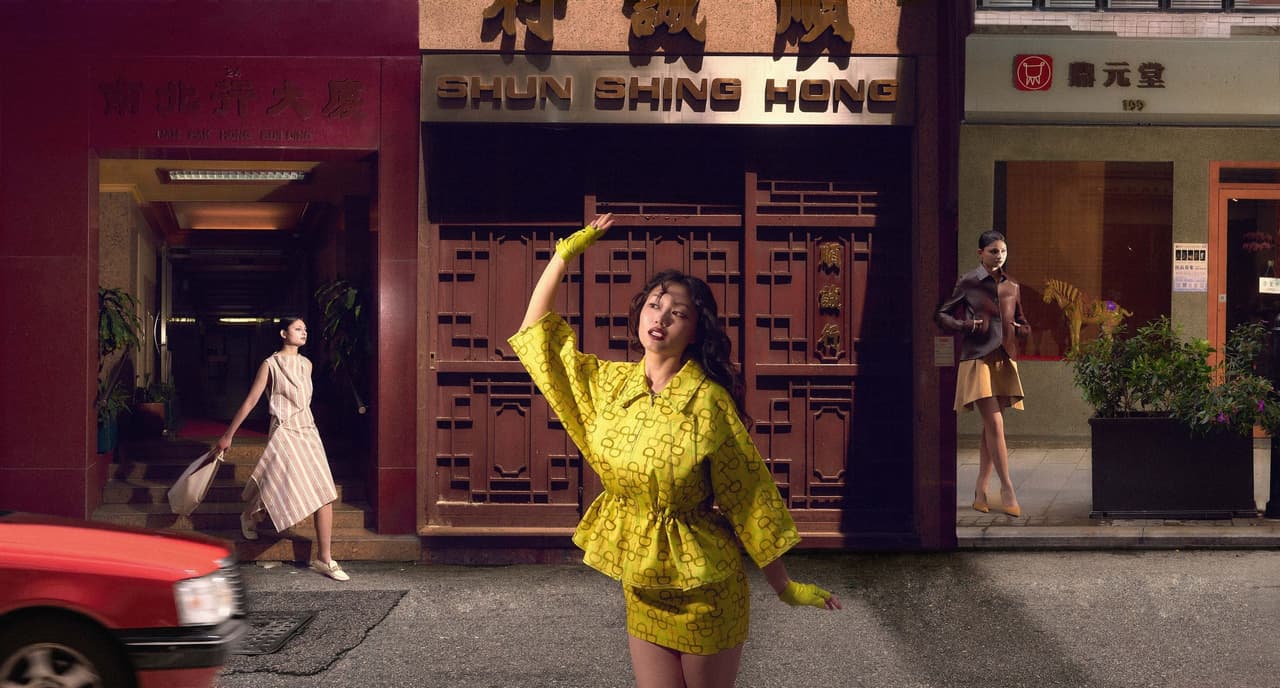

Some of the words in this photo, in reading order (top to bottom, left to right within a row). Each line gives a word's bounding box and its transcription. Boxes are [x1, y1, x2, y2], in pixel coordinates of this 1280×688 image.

[437, 76, 572, 101] SHUN
[595, 77, 742, 102] SHING
[764, 78, 900, 102] HONG
[1121, 99, 1146, 112] 199
